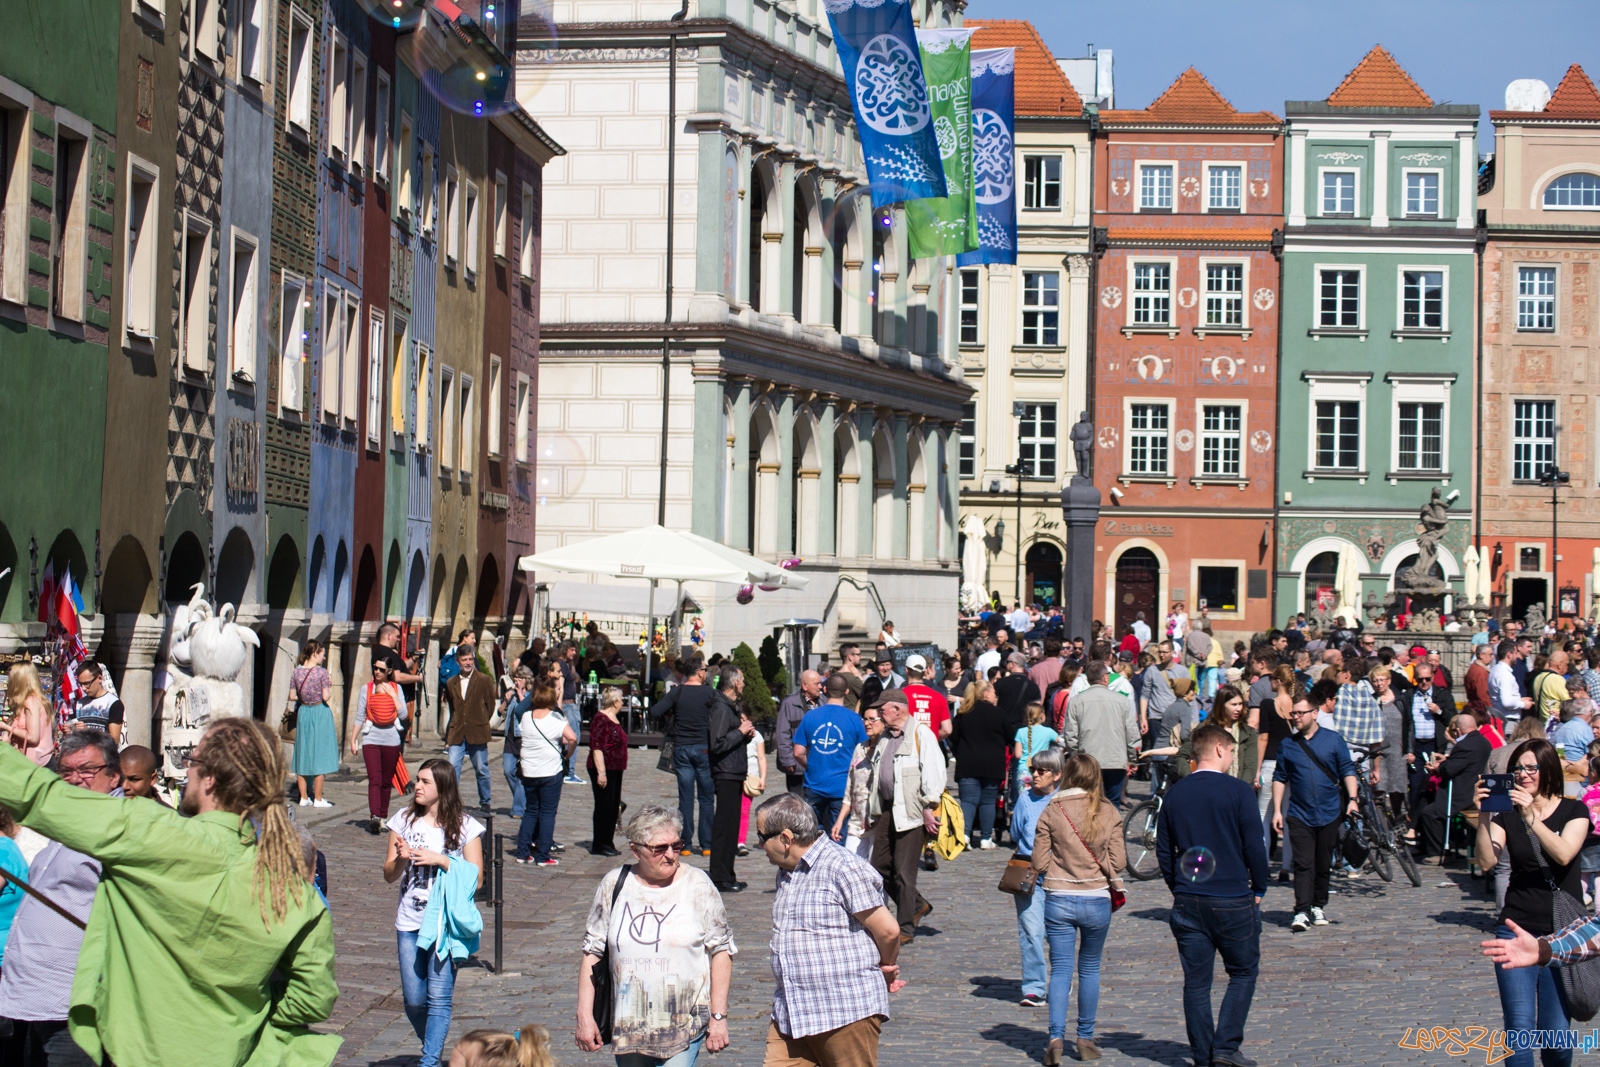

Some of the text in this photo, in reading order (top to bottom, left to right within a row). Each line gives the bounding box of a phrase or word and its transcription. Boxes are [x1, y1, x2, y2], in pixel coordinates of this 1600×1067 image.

[1029, 511, 1060, 530] Bar
[1120, 522, 1174, 534] Bank Pekao
[621, 565, 644, 574] TYSKIE
[915, 700, 929, 709] TAK
[618, 957, 671, 972] NEW YORK CITY
